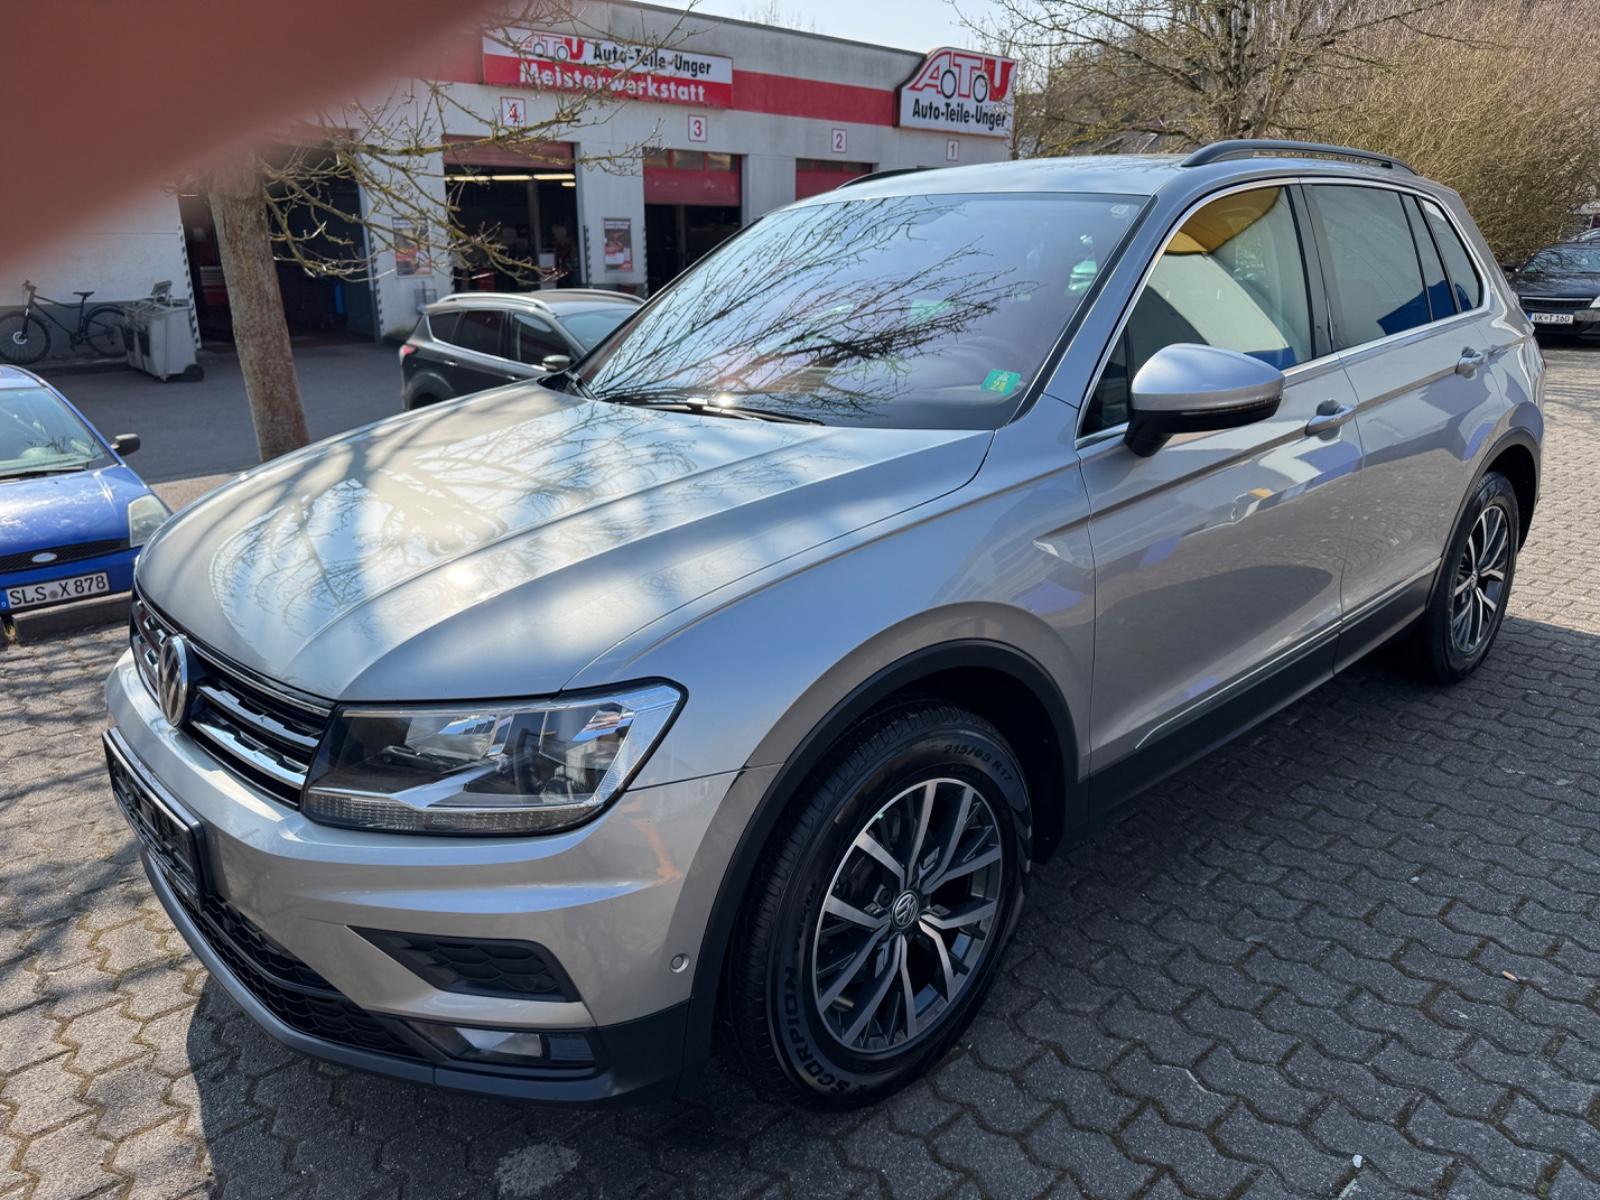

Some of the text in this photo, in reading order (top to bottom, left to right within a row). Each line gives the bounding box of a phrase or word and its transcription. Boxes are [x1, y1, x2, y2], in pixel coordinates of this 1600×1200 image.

[520, 61, 705, 101] Meisterwerkstatt
[693, 119, 702, 137] 3
[912, 98, 1006, 131] Auto-Teile-Unger
[835, 133, 843, 149] 2
[9, 586, 47, 606] SLS
[58, 581, 71, 597] X
[74, 575, 107, 594] 878
[784, 966, 850, 1092] SCORPION
